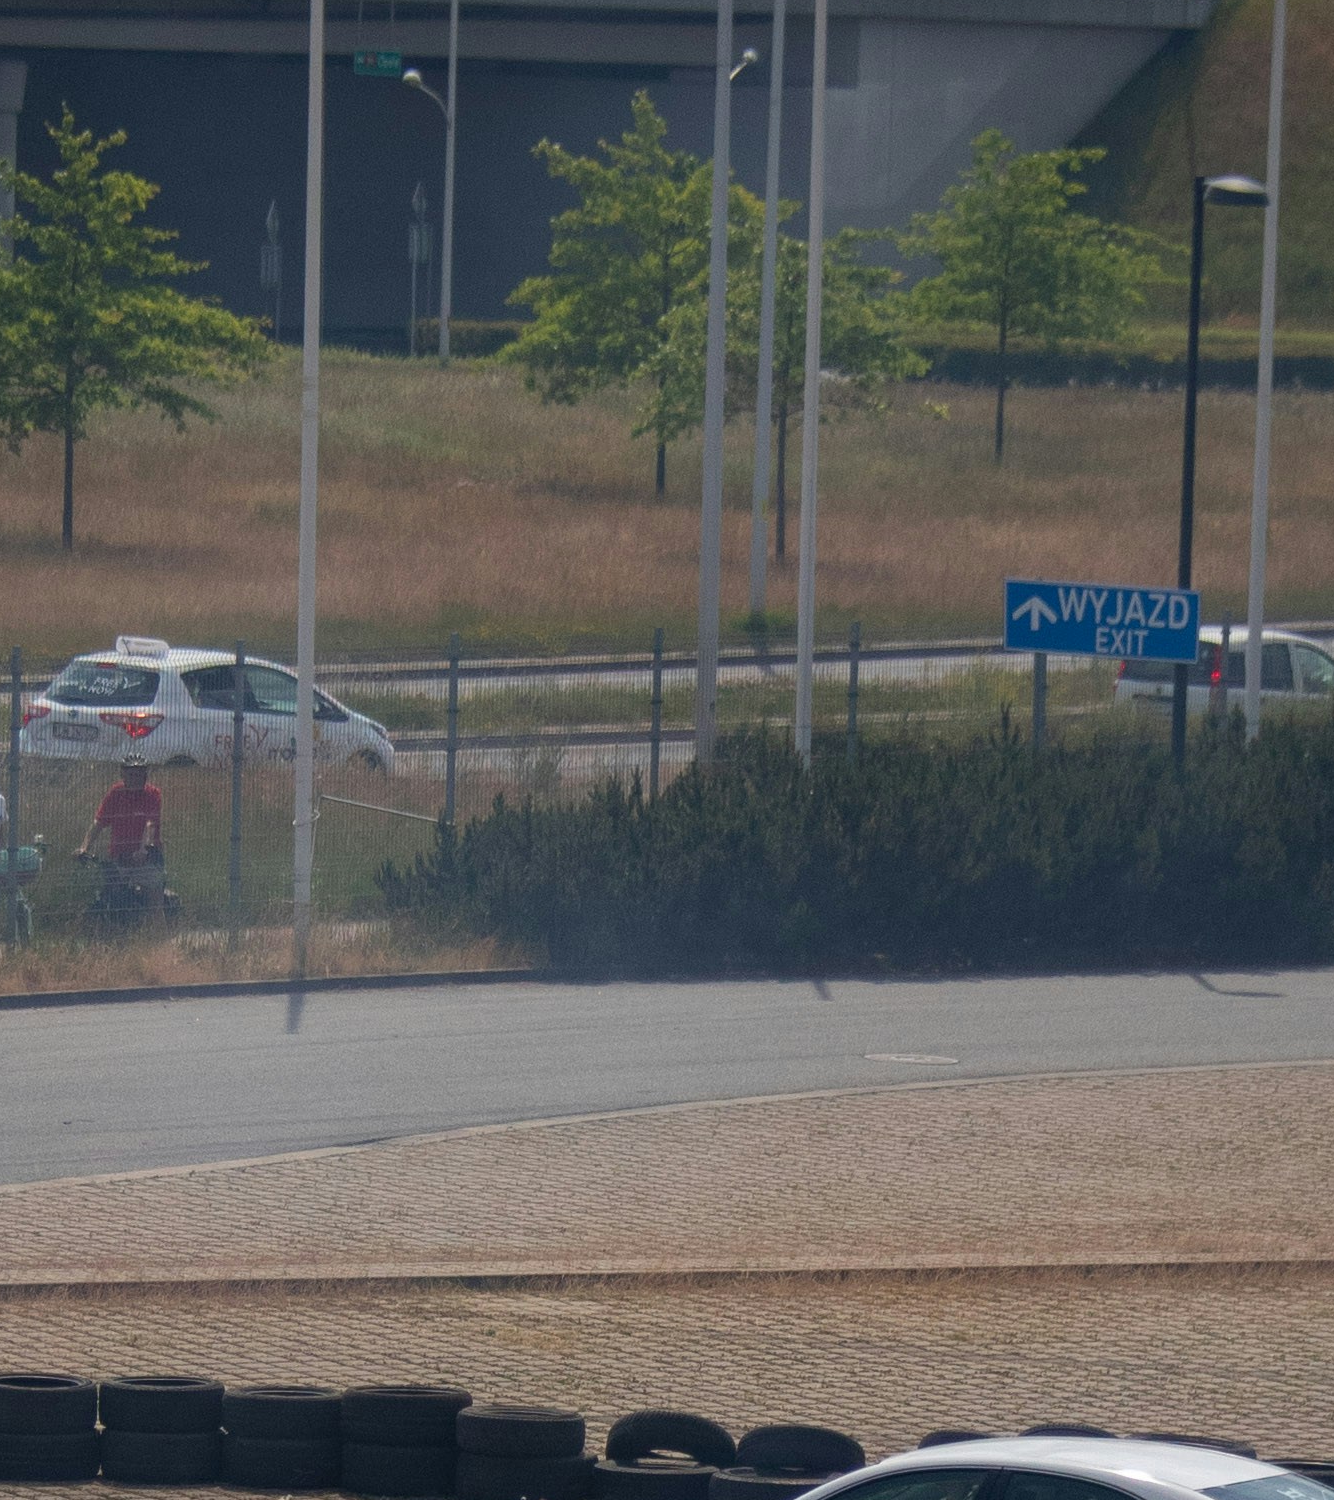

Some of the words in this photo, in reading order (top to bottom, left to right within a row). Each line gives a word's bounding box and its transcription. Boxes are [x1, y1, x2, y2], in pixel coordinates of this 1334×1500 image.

[1057, 587, 1190, 629] WYJAZD
[1095, 626, 1150, 656] EXIT
[215, 734, 251, 750] FRE
